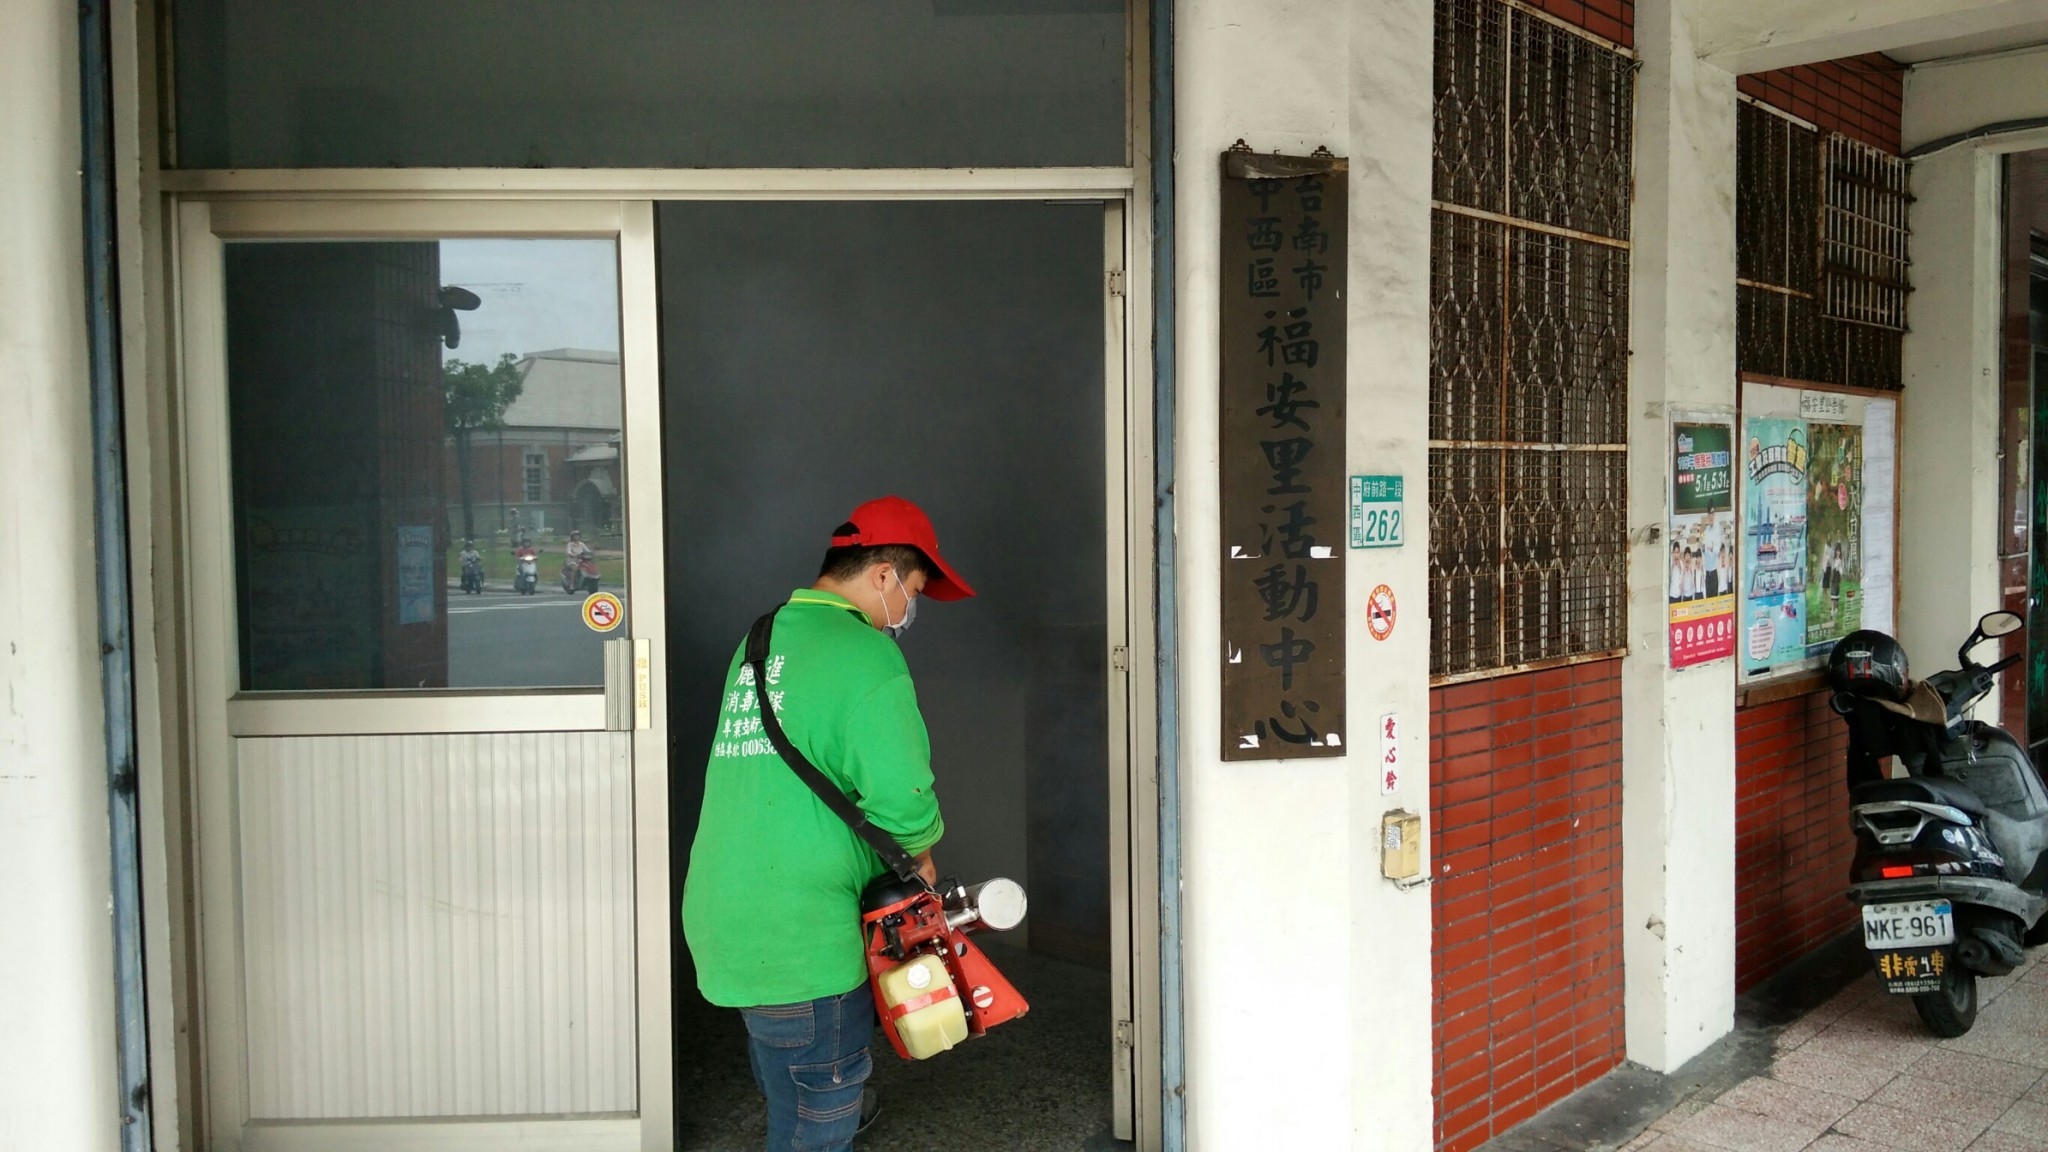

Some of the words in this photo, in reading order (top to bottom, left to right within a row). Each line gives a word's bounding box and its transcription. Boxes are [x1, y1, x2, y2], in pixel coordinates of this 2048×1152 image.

[1246, 178, 1284, 299] 中西區
[1291, 177, 1329, 301] 台南市
[1352, 482, 1362, 542] 中西區
[1362, 480, 1403, 498] 府前路一段
[1253, 308, 1321, 745] 福安里活動中心
[1365, 509, 1401, 543] 262
[638, 674, 647, 708] PUSH
[725, 689, 785, 714] 消毒隊
[1384, 716, 1398, 791] 愛心鈴
